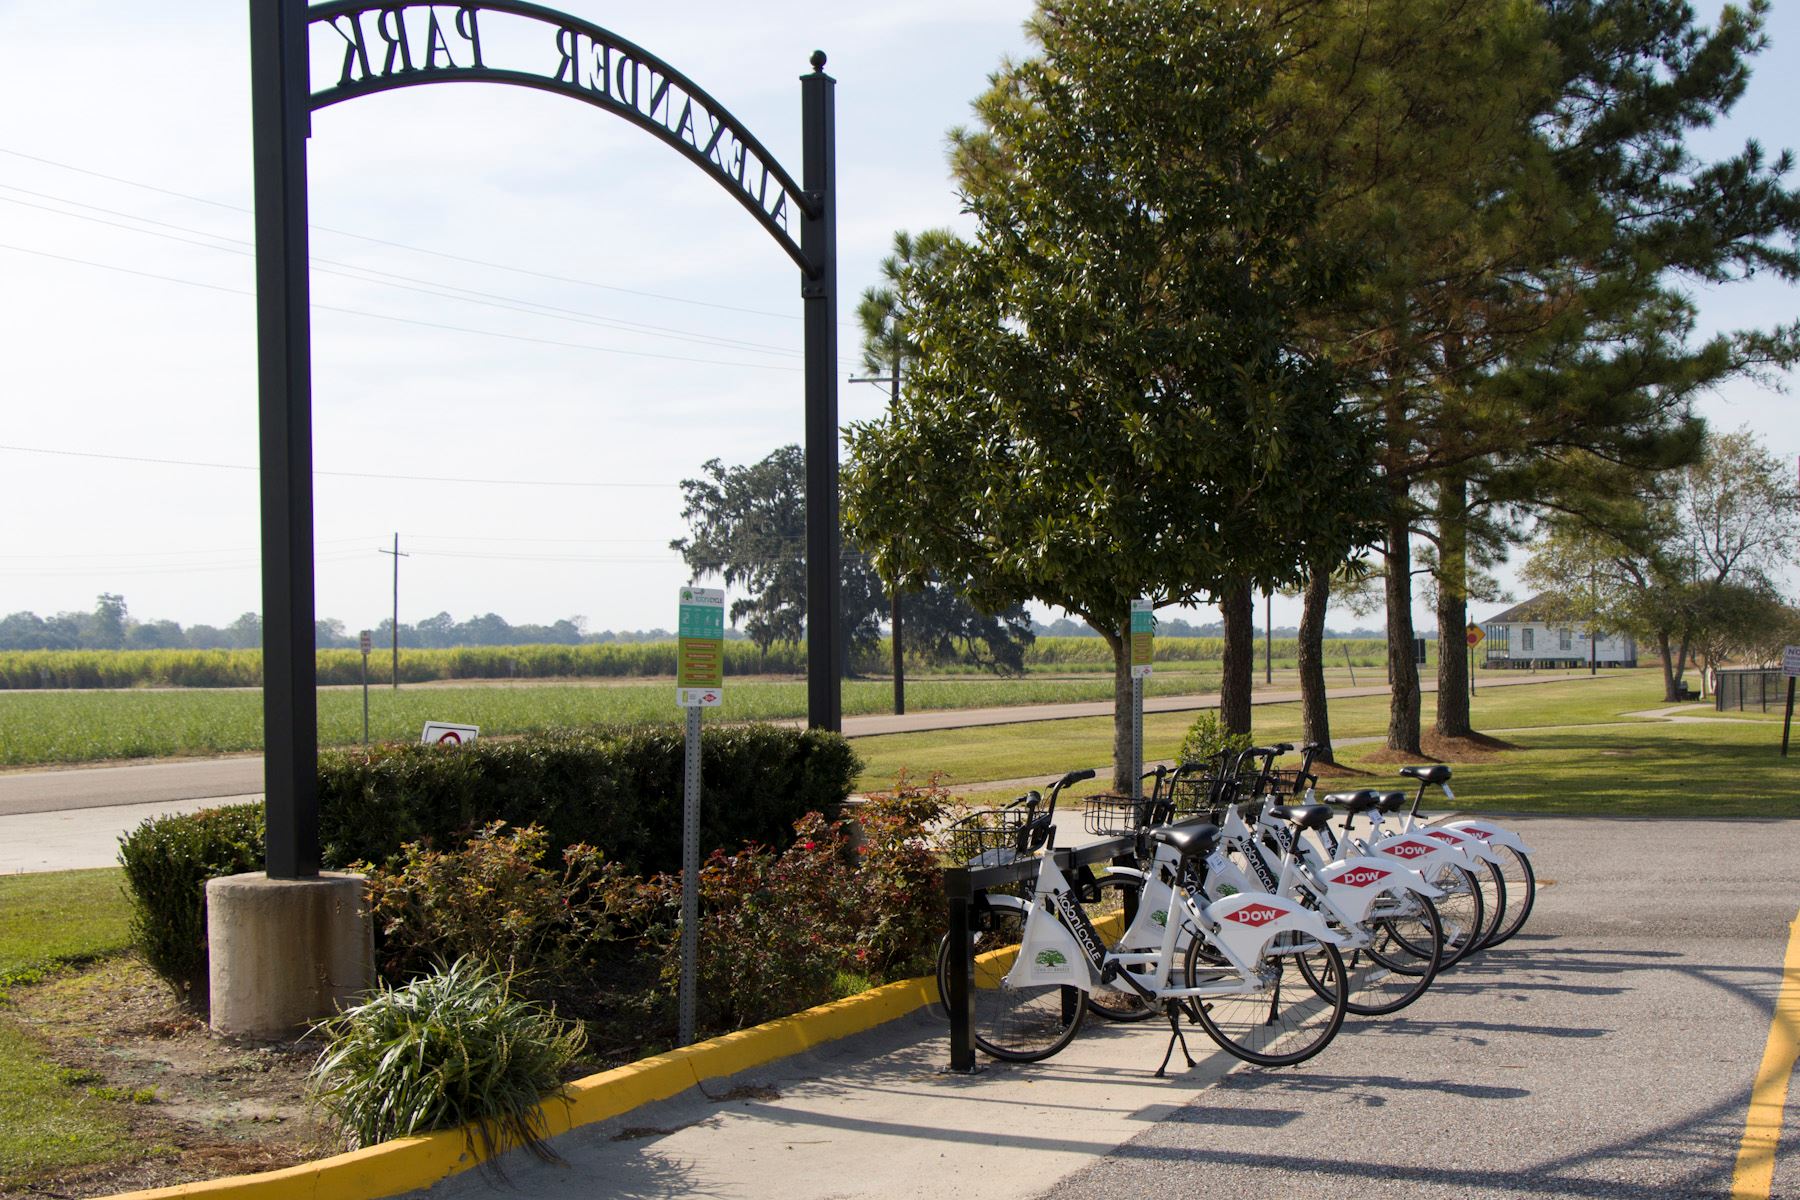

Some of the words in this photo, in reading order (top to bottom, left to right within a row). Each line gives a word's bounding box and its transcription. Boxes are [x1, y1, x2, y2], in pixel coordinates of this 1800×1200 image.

[1394, 845, 1427, 855] DOW
[1343, 871, 1380, 884] DOW
[1238, 909, 1278, 923] DOW
